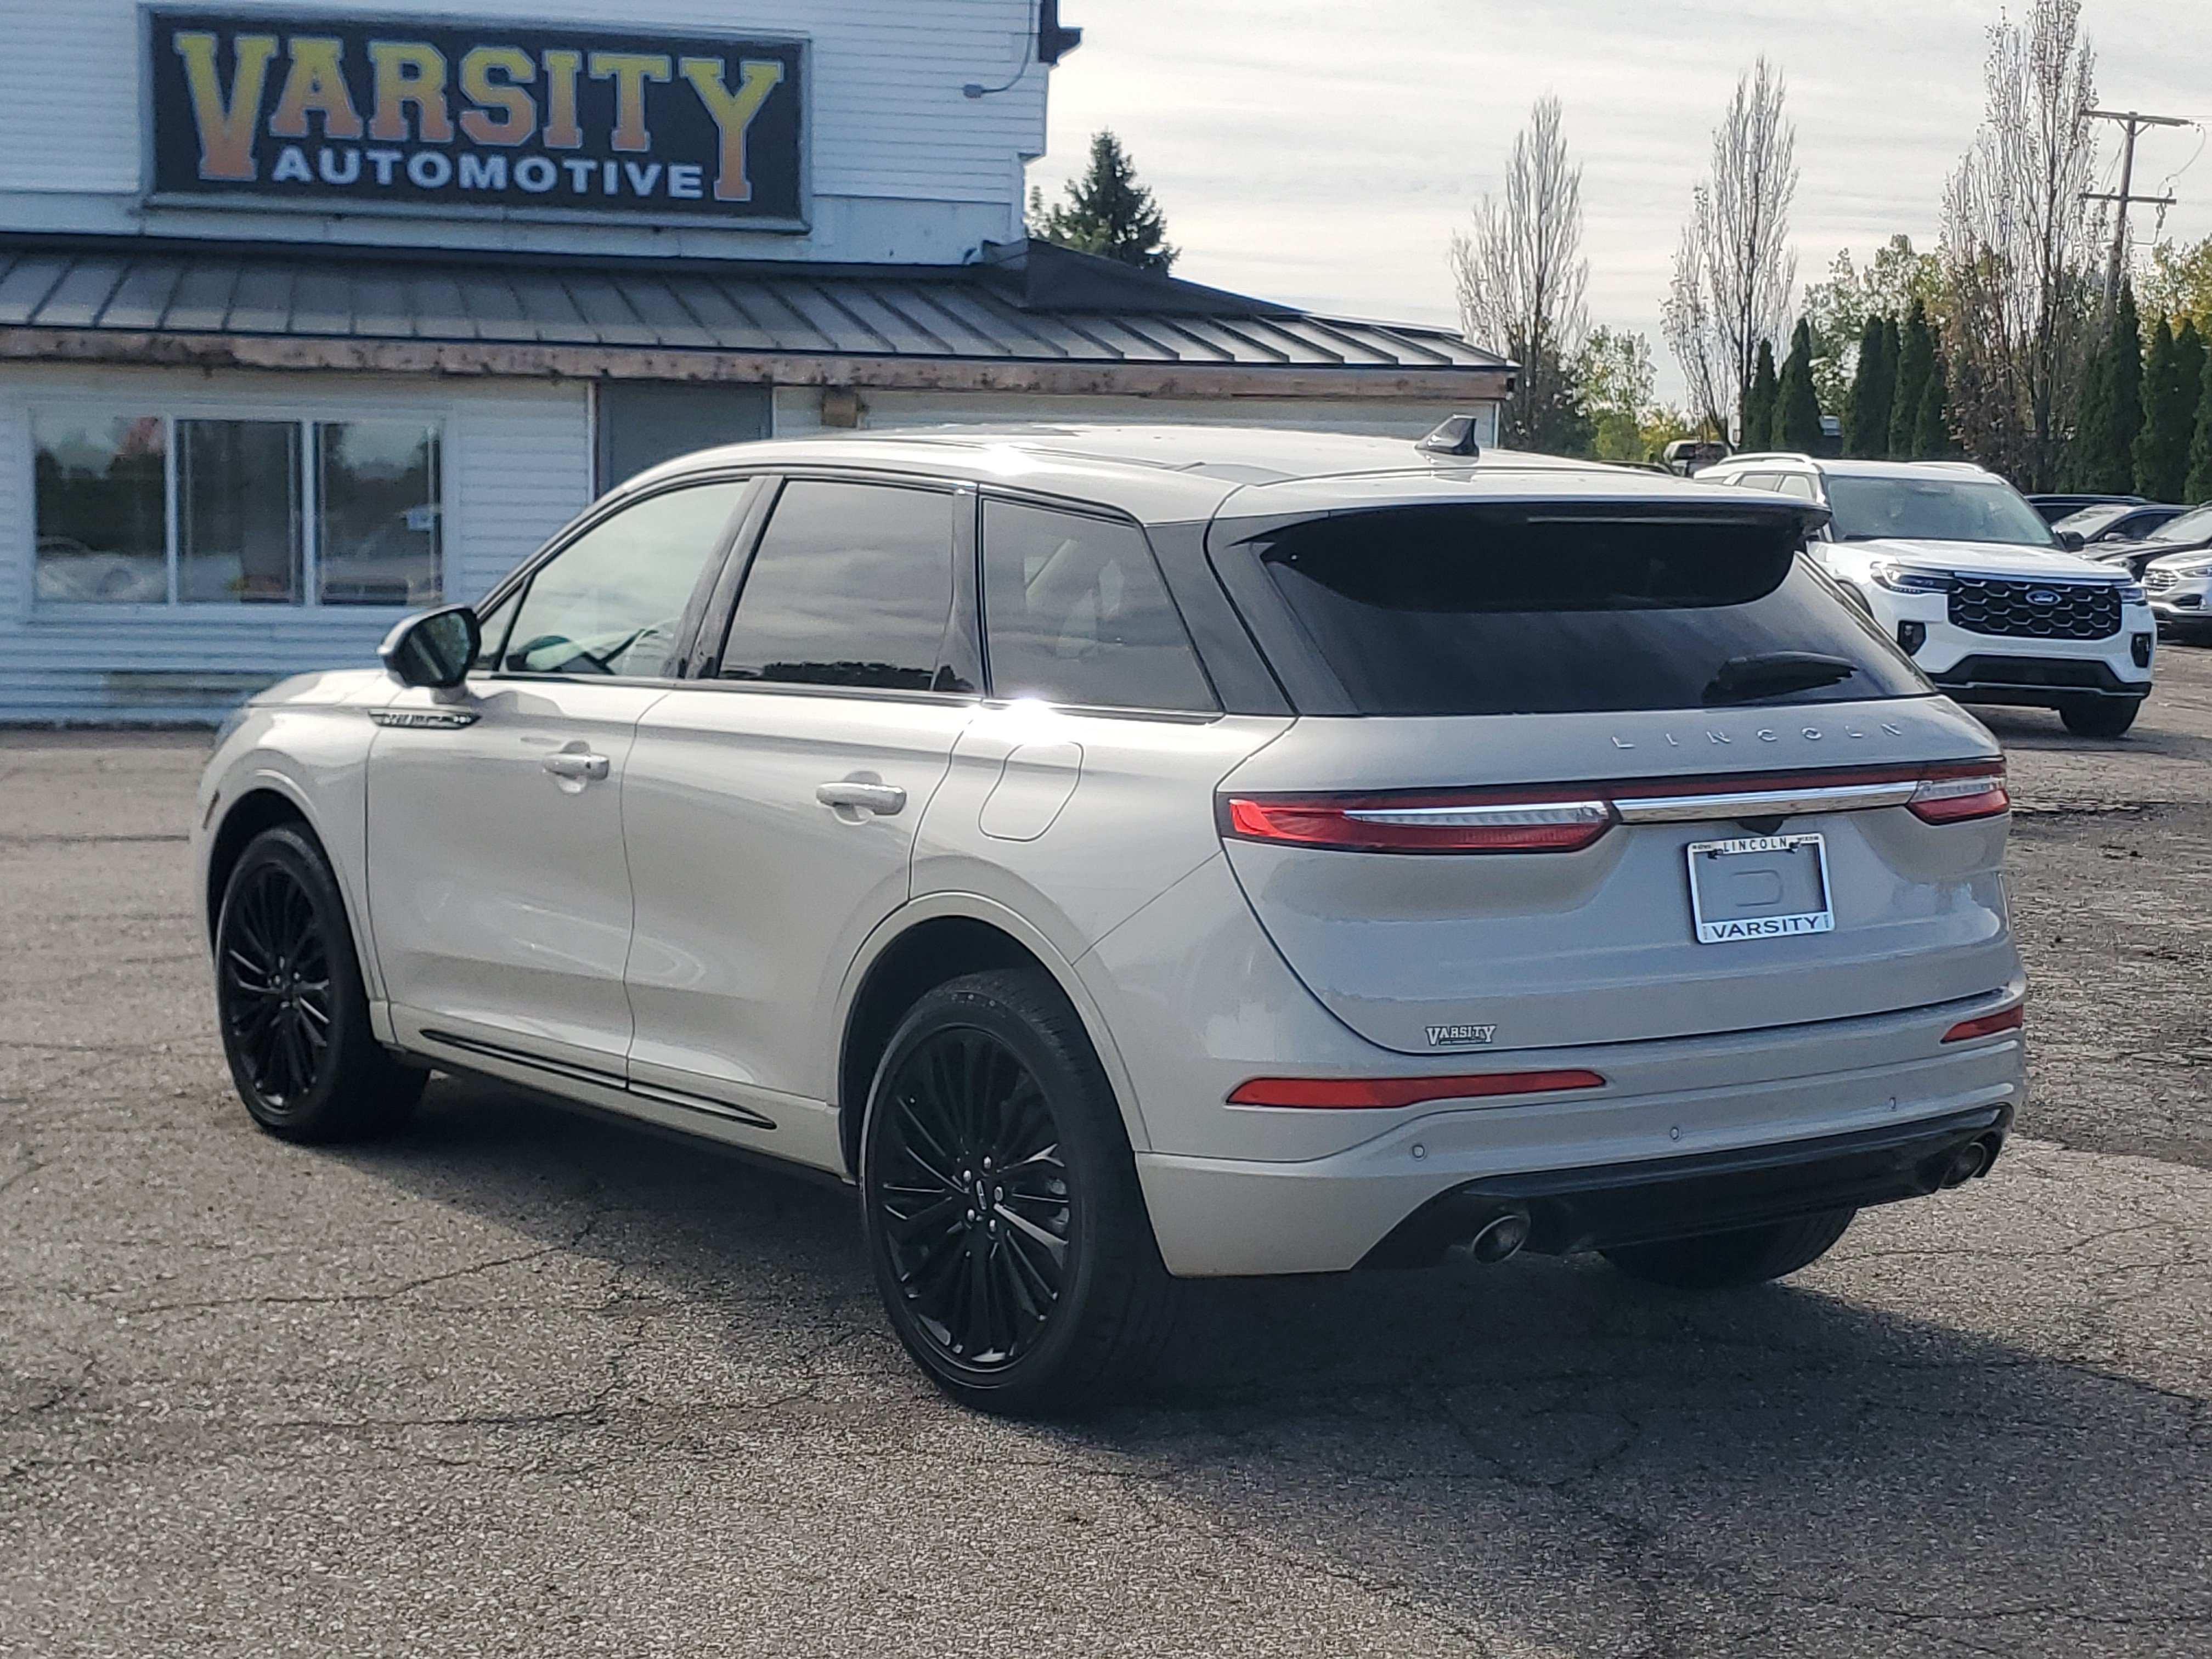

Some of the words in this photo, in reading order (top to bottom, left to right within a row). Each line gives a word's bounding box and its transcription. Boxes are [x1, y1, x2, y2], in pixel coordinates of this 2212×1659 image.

[173, 32, 785, 202] VARSITY
[271, 145, 705, 200] AUTOMOTIVE
[1611, 722, 1903, 749] LINCOLN
[1723, 837, 1787, 853] LINCOLN
[1711, 915, 1819, 939] VARSITY
[1426, 1024, 1497, 1046] VARSITY
